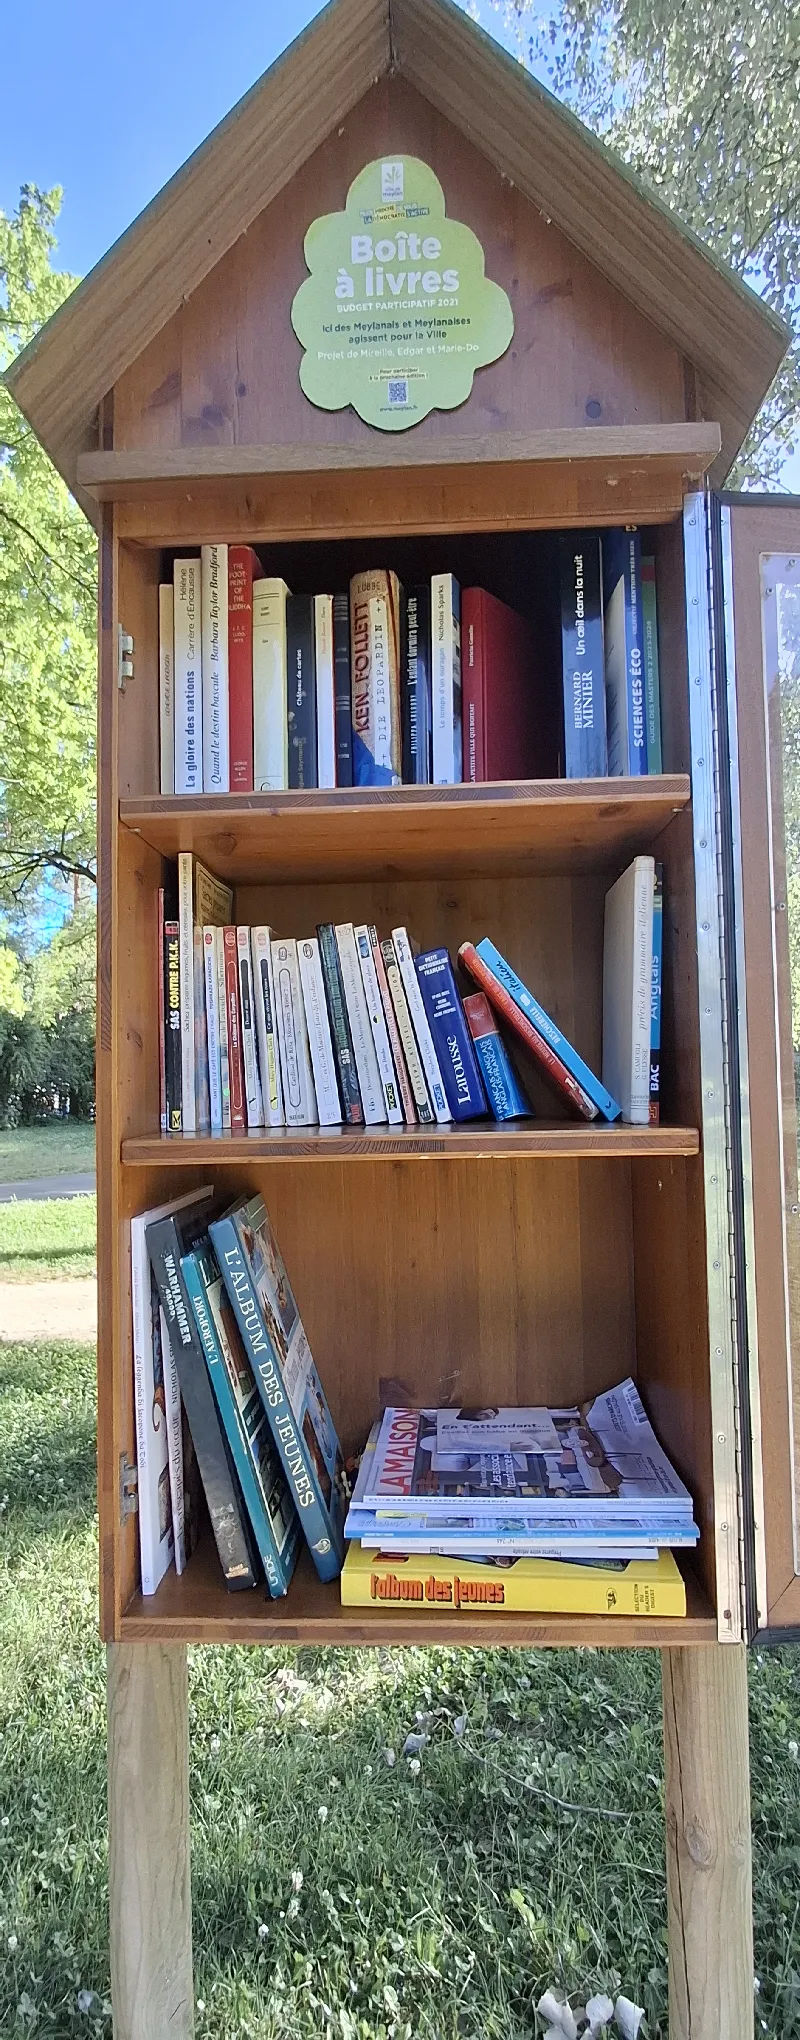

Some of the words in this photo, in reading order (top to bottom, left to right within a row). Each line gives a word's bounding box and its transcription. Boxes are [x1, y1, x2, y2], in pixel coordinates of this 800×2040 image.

[351, 231, 442, 264] Boîte
[334, 268, 354, 298] à
[366, 267, 460, 296] livres
[337, 303, 372, 312] BUDGET
[376, 300, 436, 310] PARTICIPATIF
[438, 298, 458, 307] 2021
[335, 324, 350, 332] des
[354, 319, 400, 332] Meylanais
[402, 320, 412, 328] et
[415, 316, 471, 328] Meylanaises
[349, 334, 388, 344] agissent
[390, 333, 412, 343] pour
[415, 332, 424, 340] la
[427, 330, 447, 340] Ville
[318, 351, 344, 361] Projet
[348, 350, 358, 358] de
[398, 346, 424, 358] Edgar
[427, 345, 436, 354] et
[438, 344, 479, 352] Marie-Do
[208, 546, 220, 589] Bradford
[573, 554, 583, 576] nuit
[186, 568, 194, 620] d'Encausse
[574, 578, 584, 589] la
[209, 590, 220, 621] Taylor
[406, 598, 419, 628] peut-être
[575, 591, 584, 618] dans
[186, 623, 195, 660] Carrère
[210, 622, 218, 662] Barbara
[353, 602, 369, 683] FOLLETT
[406, 630, 417, 658] dormira
[576, 620, 586, 638] œil
[439, 648, 447, 677] ouragan
[576, 642, 586, 655] Un
[628, 648, 641, 676] ÉCO
[296, 671, 302, 679] de
[374, 625, 385, 705] LEOPARDIN
[406, 659, 417, 686] L'enfant
[184, 671, 195, 712] nations
[210, 672, 219, 708] bascule
[572, 671, 582, 729] BERNARD
[582, 670, 593, 728] MINIER
[185, 716, 195, 736] des
[210, 710, 219, 739] destin
[354, 694, 369, 732] KEN
[377, 716, 386, 740] DIE
[438, 720, 445, 729] Le
[632, 680, 644, 747] SCIENCES
[185, 740, 198, 771] gloire
[210, 740, 219, 749] le
[186, 776, 195, 788] La
[210, 750, 221, 784] Quand
[168, 940, 178, 969] P.K.K.
[639, 931, 648, 984] grammaire
[169, 971, 180, 1009] CONTRE
[392, 974, 400, 993] LION
[496, 960, 520, 992] italien
[650, 955, 661, 1021] Anglais
[638, 989, 646, 998] de
[170, 1010, 180, 1030] SAS
[530, 1006, 560, 1044] BESCHERELLE
[637, 1001, 647, 1031] précis
[402, 1024, 414, 1056] KESSEL
[340, 1049, 350, 1065] SAS
[446, 1034, 471, 1106] Larousse
[412, 1062, 423, 1095] JOSEPH
[650, 1064, 659, 1091] BAC
[385, 1083, 397, 1110] POCKET
[432, 1083, 446, 1109] POCKET
[164, 1254, 192, 1345] WARHAMMER
[193, 1296, 219, 1365] L'AEROPORT
[136, 1355, 142, 1364] La
[224, 1247, 268, 1355] L'ALBUM
[258, 1358, 283, 1407] DES
[275, 1413, 315, 1507] JEUNES
[172, 1448, 180, 1465] du
[370, 1573, 424, 1601] l'album
[425, 1575, 452, 1601] des
[454, 1575, 505, 1608] jeunes
